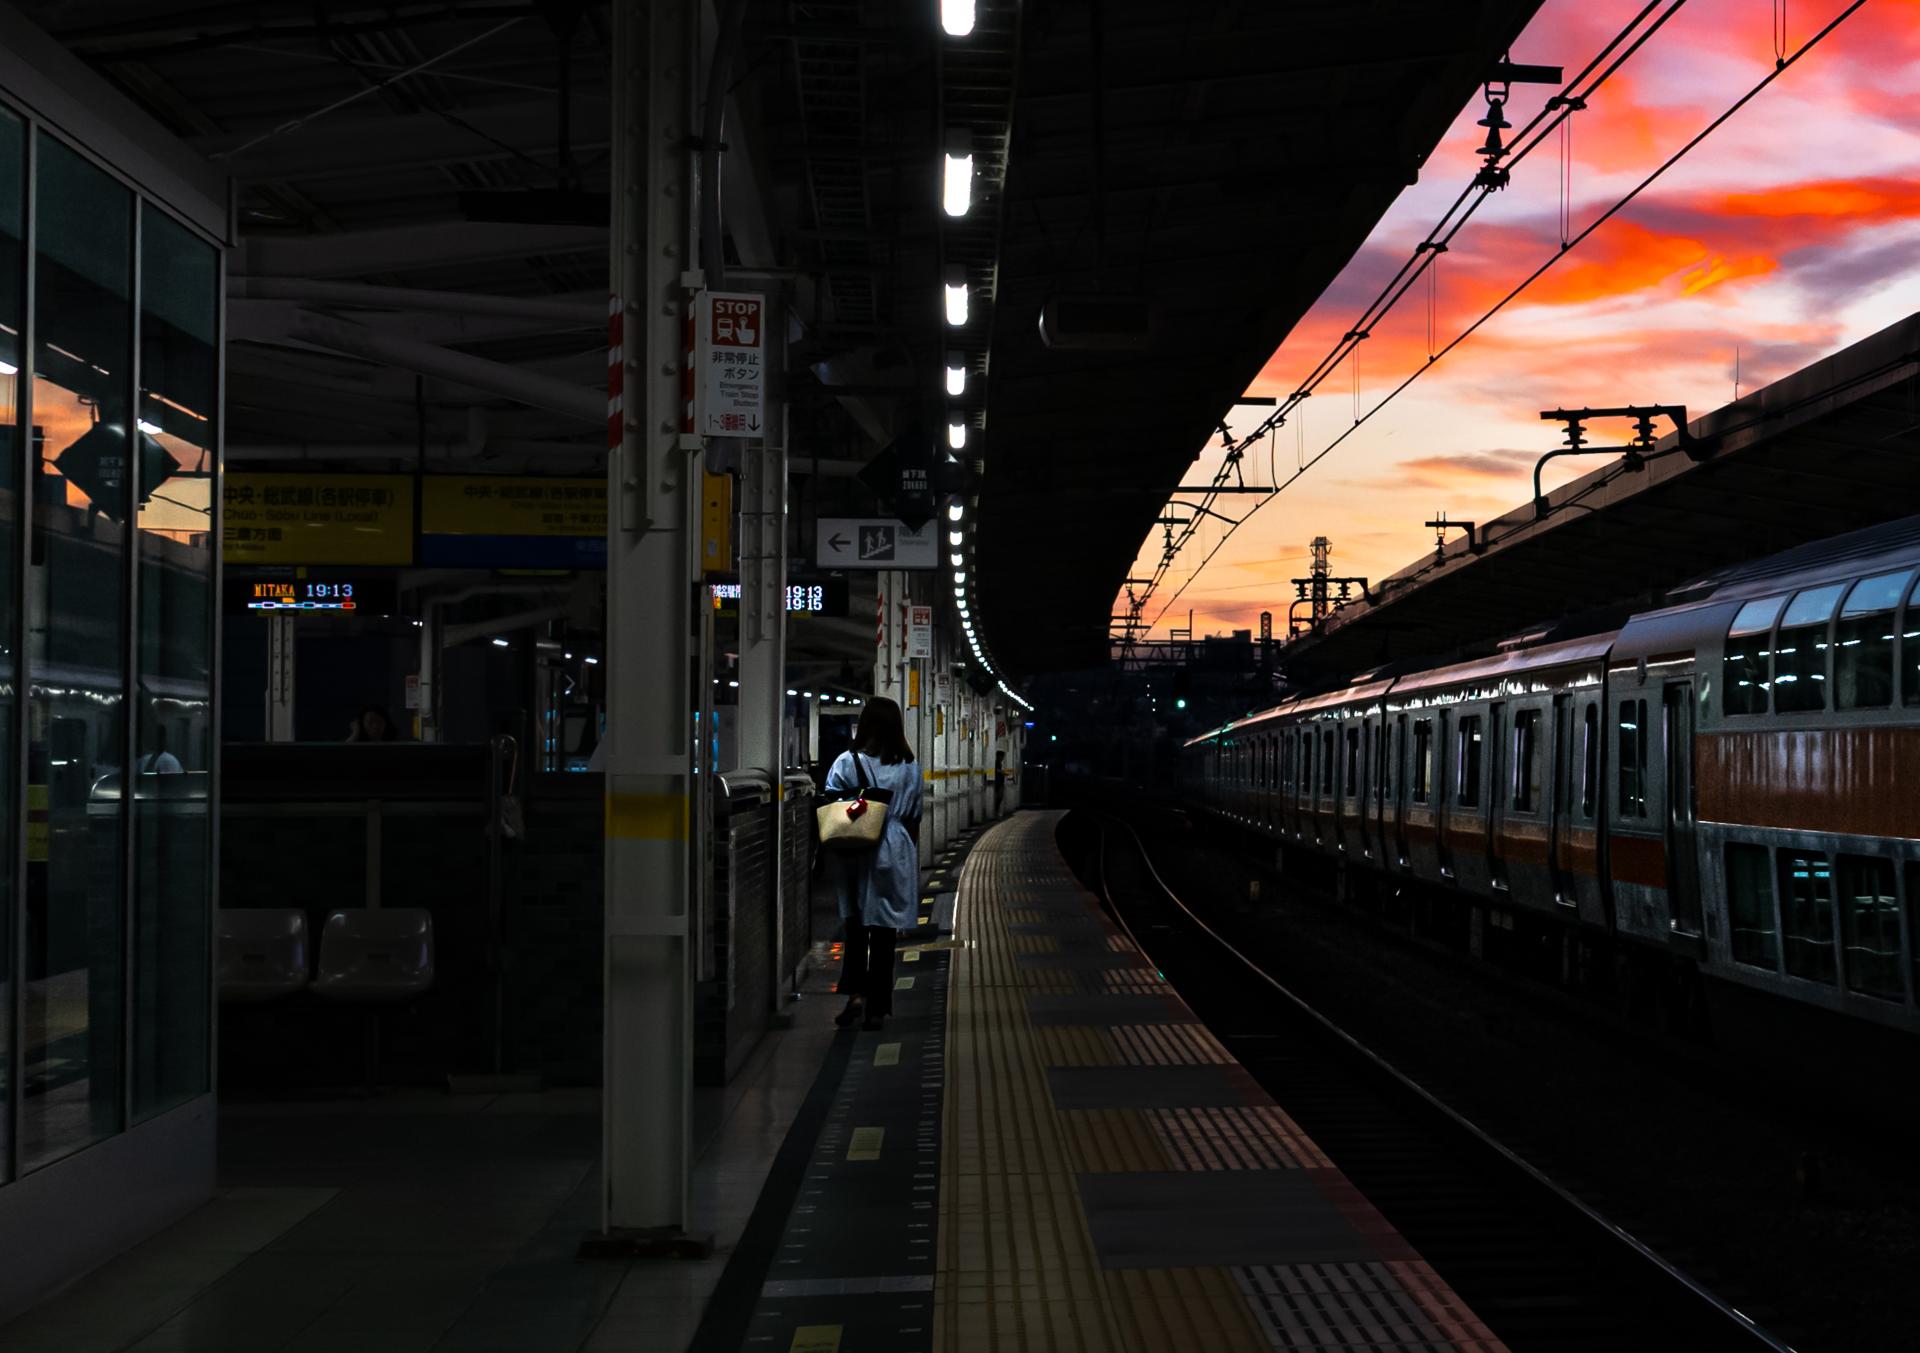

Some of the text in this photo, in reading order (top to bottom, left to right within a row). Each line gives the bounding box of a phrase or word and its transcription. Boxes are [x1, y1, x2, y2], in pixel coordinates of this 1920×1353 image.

[716, 301, 757, 315] STOP
[712, 351, 760, 366] 非常停止
[724, 367, 760, 380] ボタン
[254, 583, 353, 597] MITAKA 19:13
[786, 585, 823, 598] 19:13
[786, 598, 823, 611] 19:15
